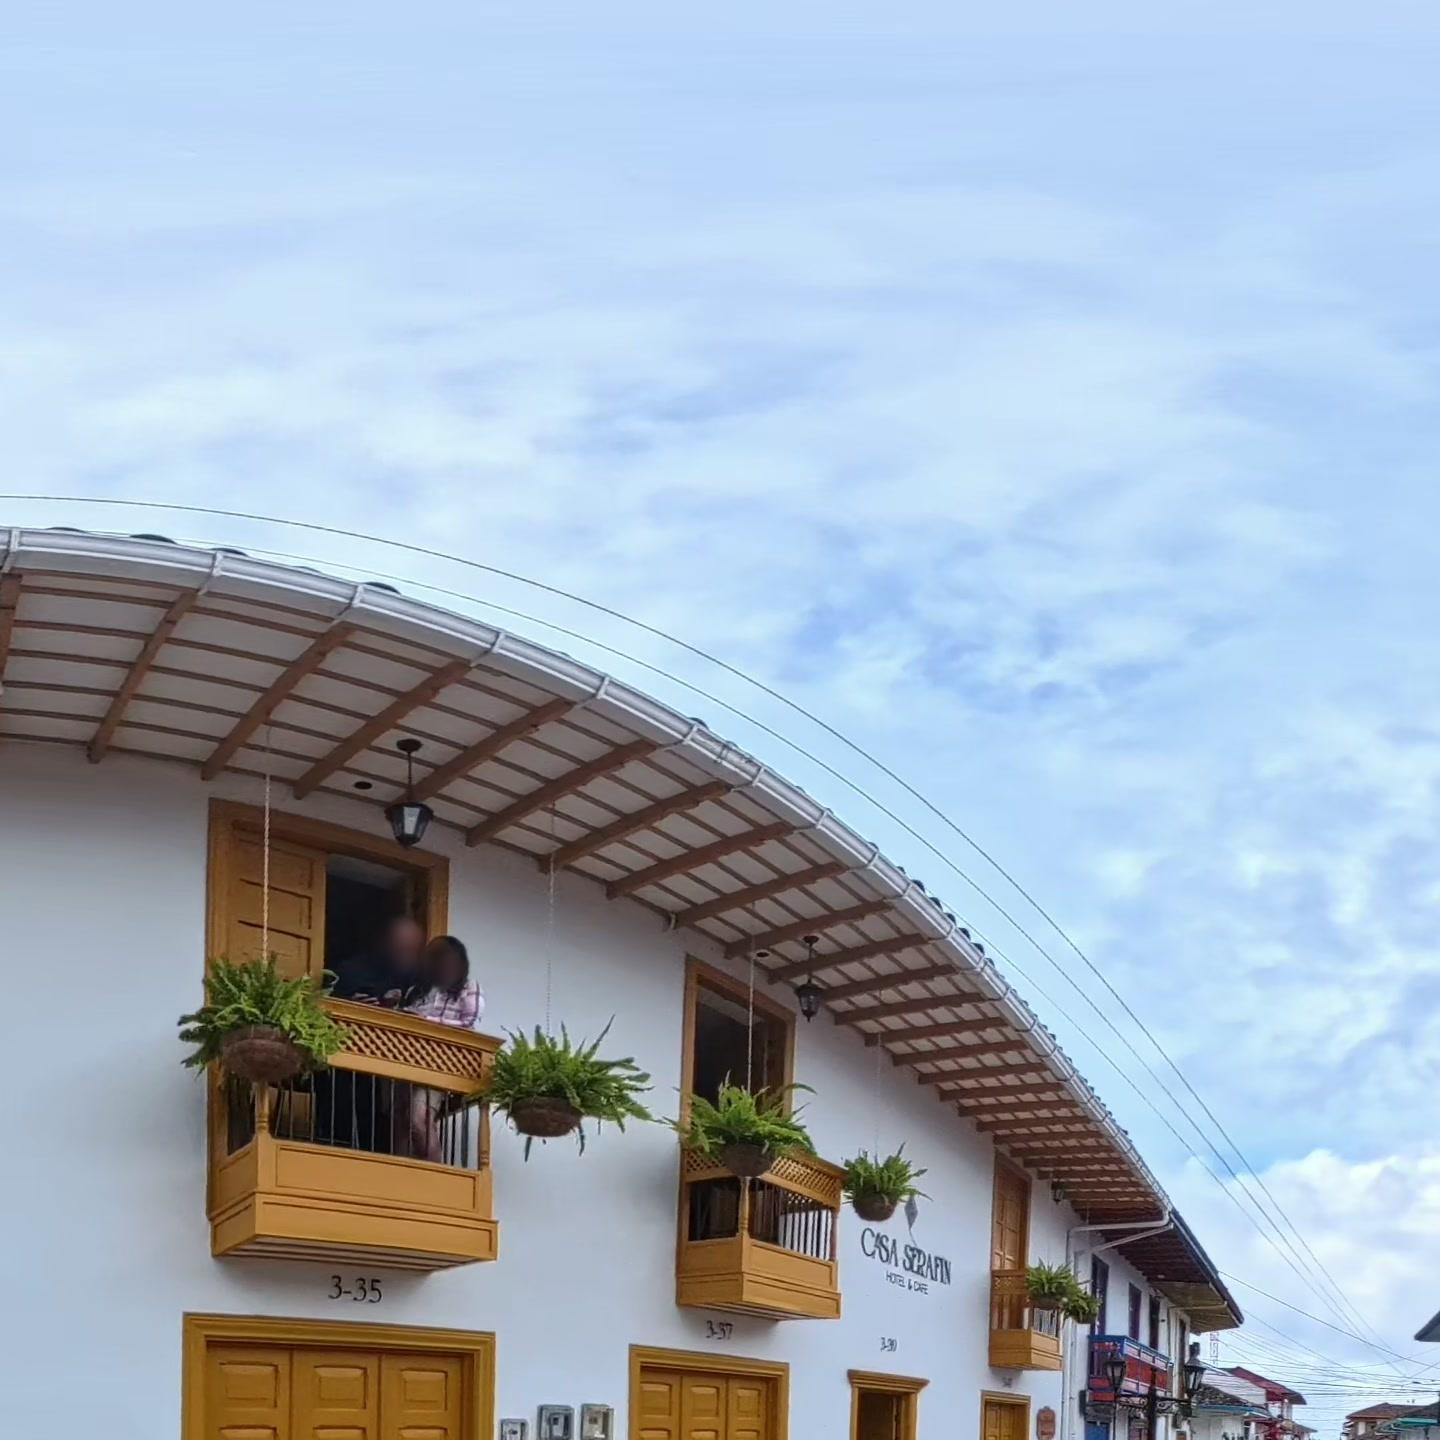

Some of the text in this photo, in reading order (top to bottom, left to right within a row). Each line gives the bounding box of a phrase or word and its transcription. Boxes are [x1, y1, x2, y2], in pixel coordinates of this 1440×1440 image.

[861, 1227, 951, 1285] CASA SERAFIN
[328, 1274, 382, 1303] 3-35
[886, 1271, 906, 1288] HOTEL
[705, 1320, 734, 1340] 3-37
